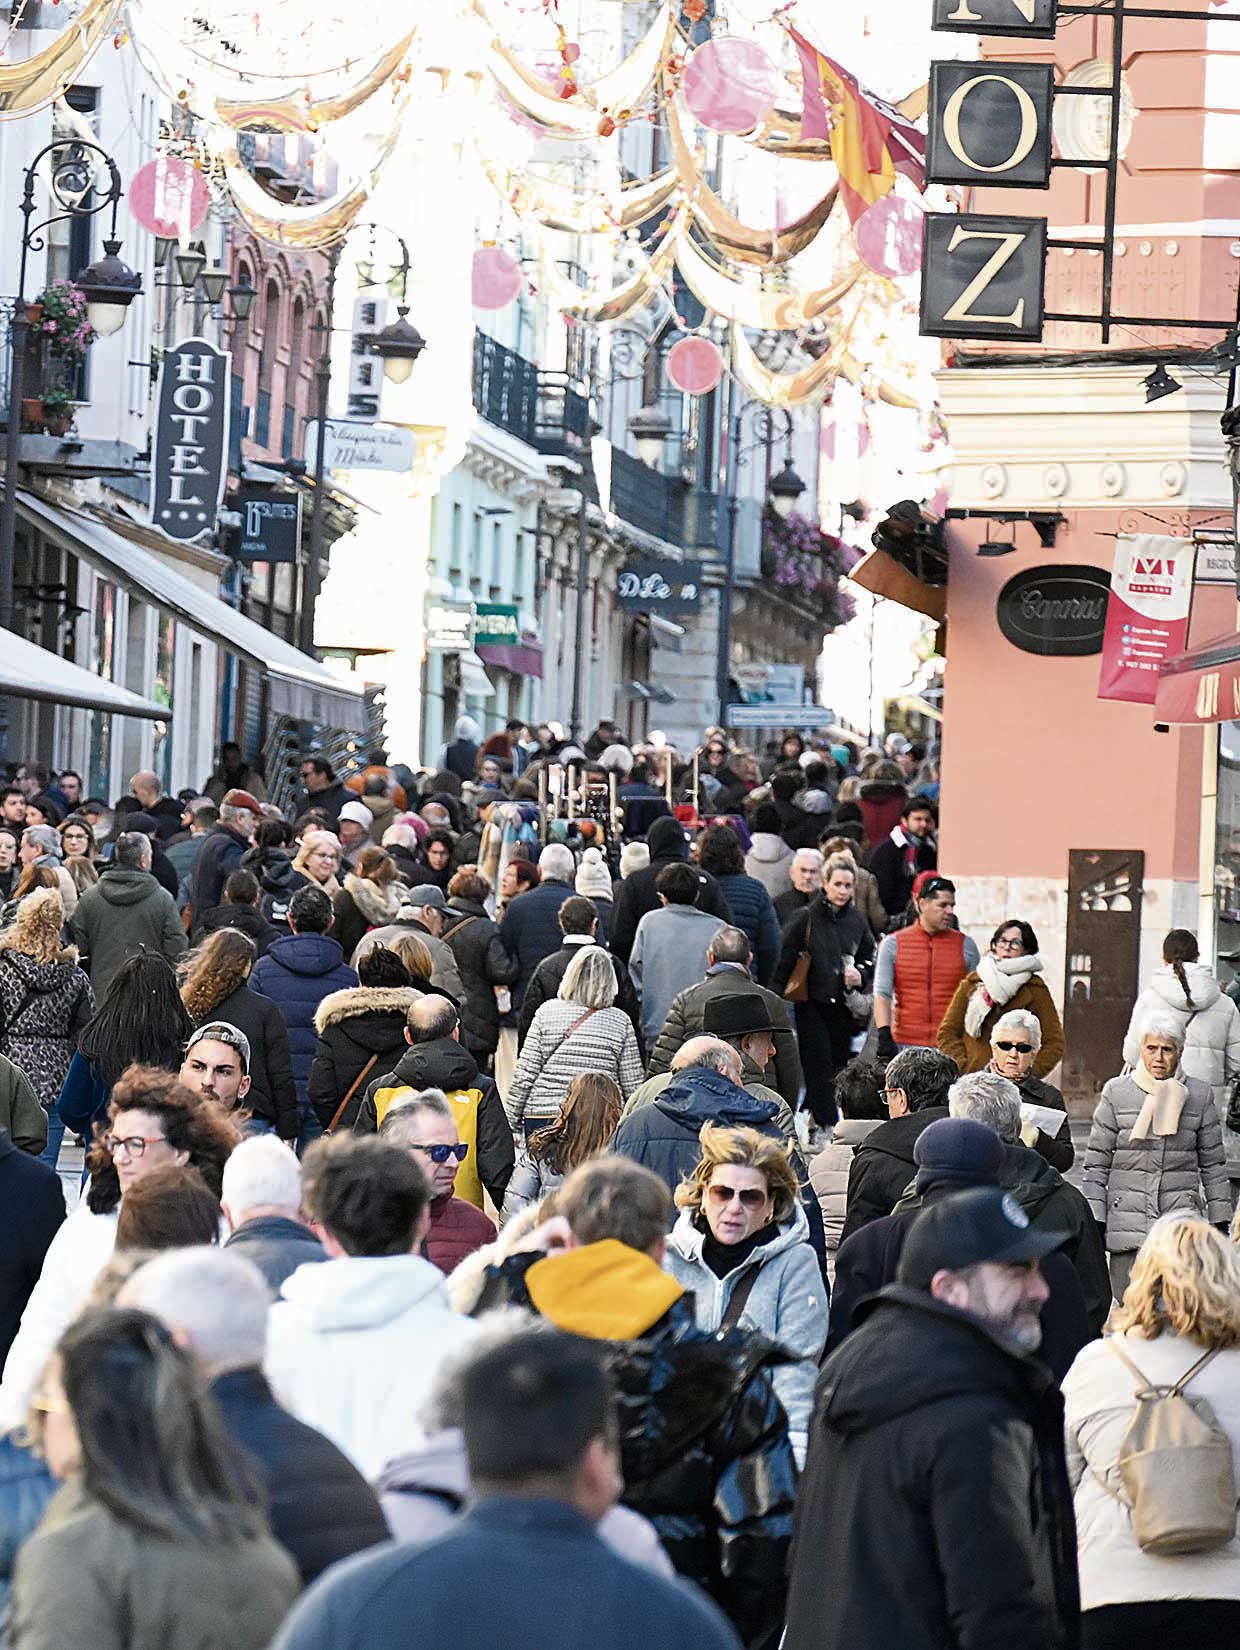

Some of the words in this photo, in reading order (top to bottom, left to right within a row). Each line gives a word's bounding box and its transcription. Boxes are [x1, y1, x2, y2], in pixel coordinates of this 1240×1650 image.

[943, 0, 1038, 329] OZ
[168, 353, 215, 505] HOTEL
[1021, 589, 1105, 620] Canarias
